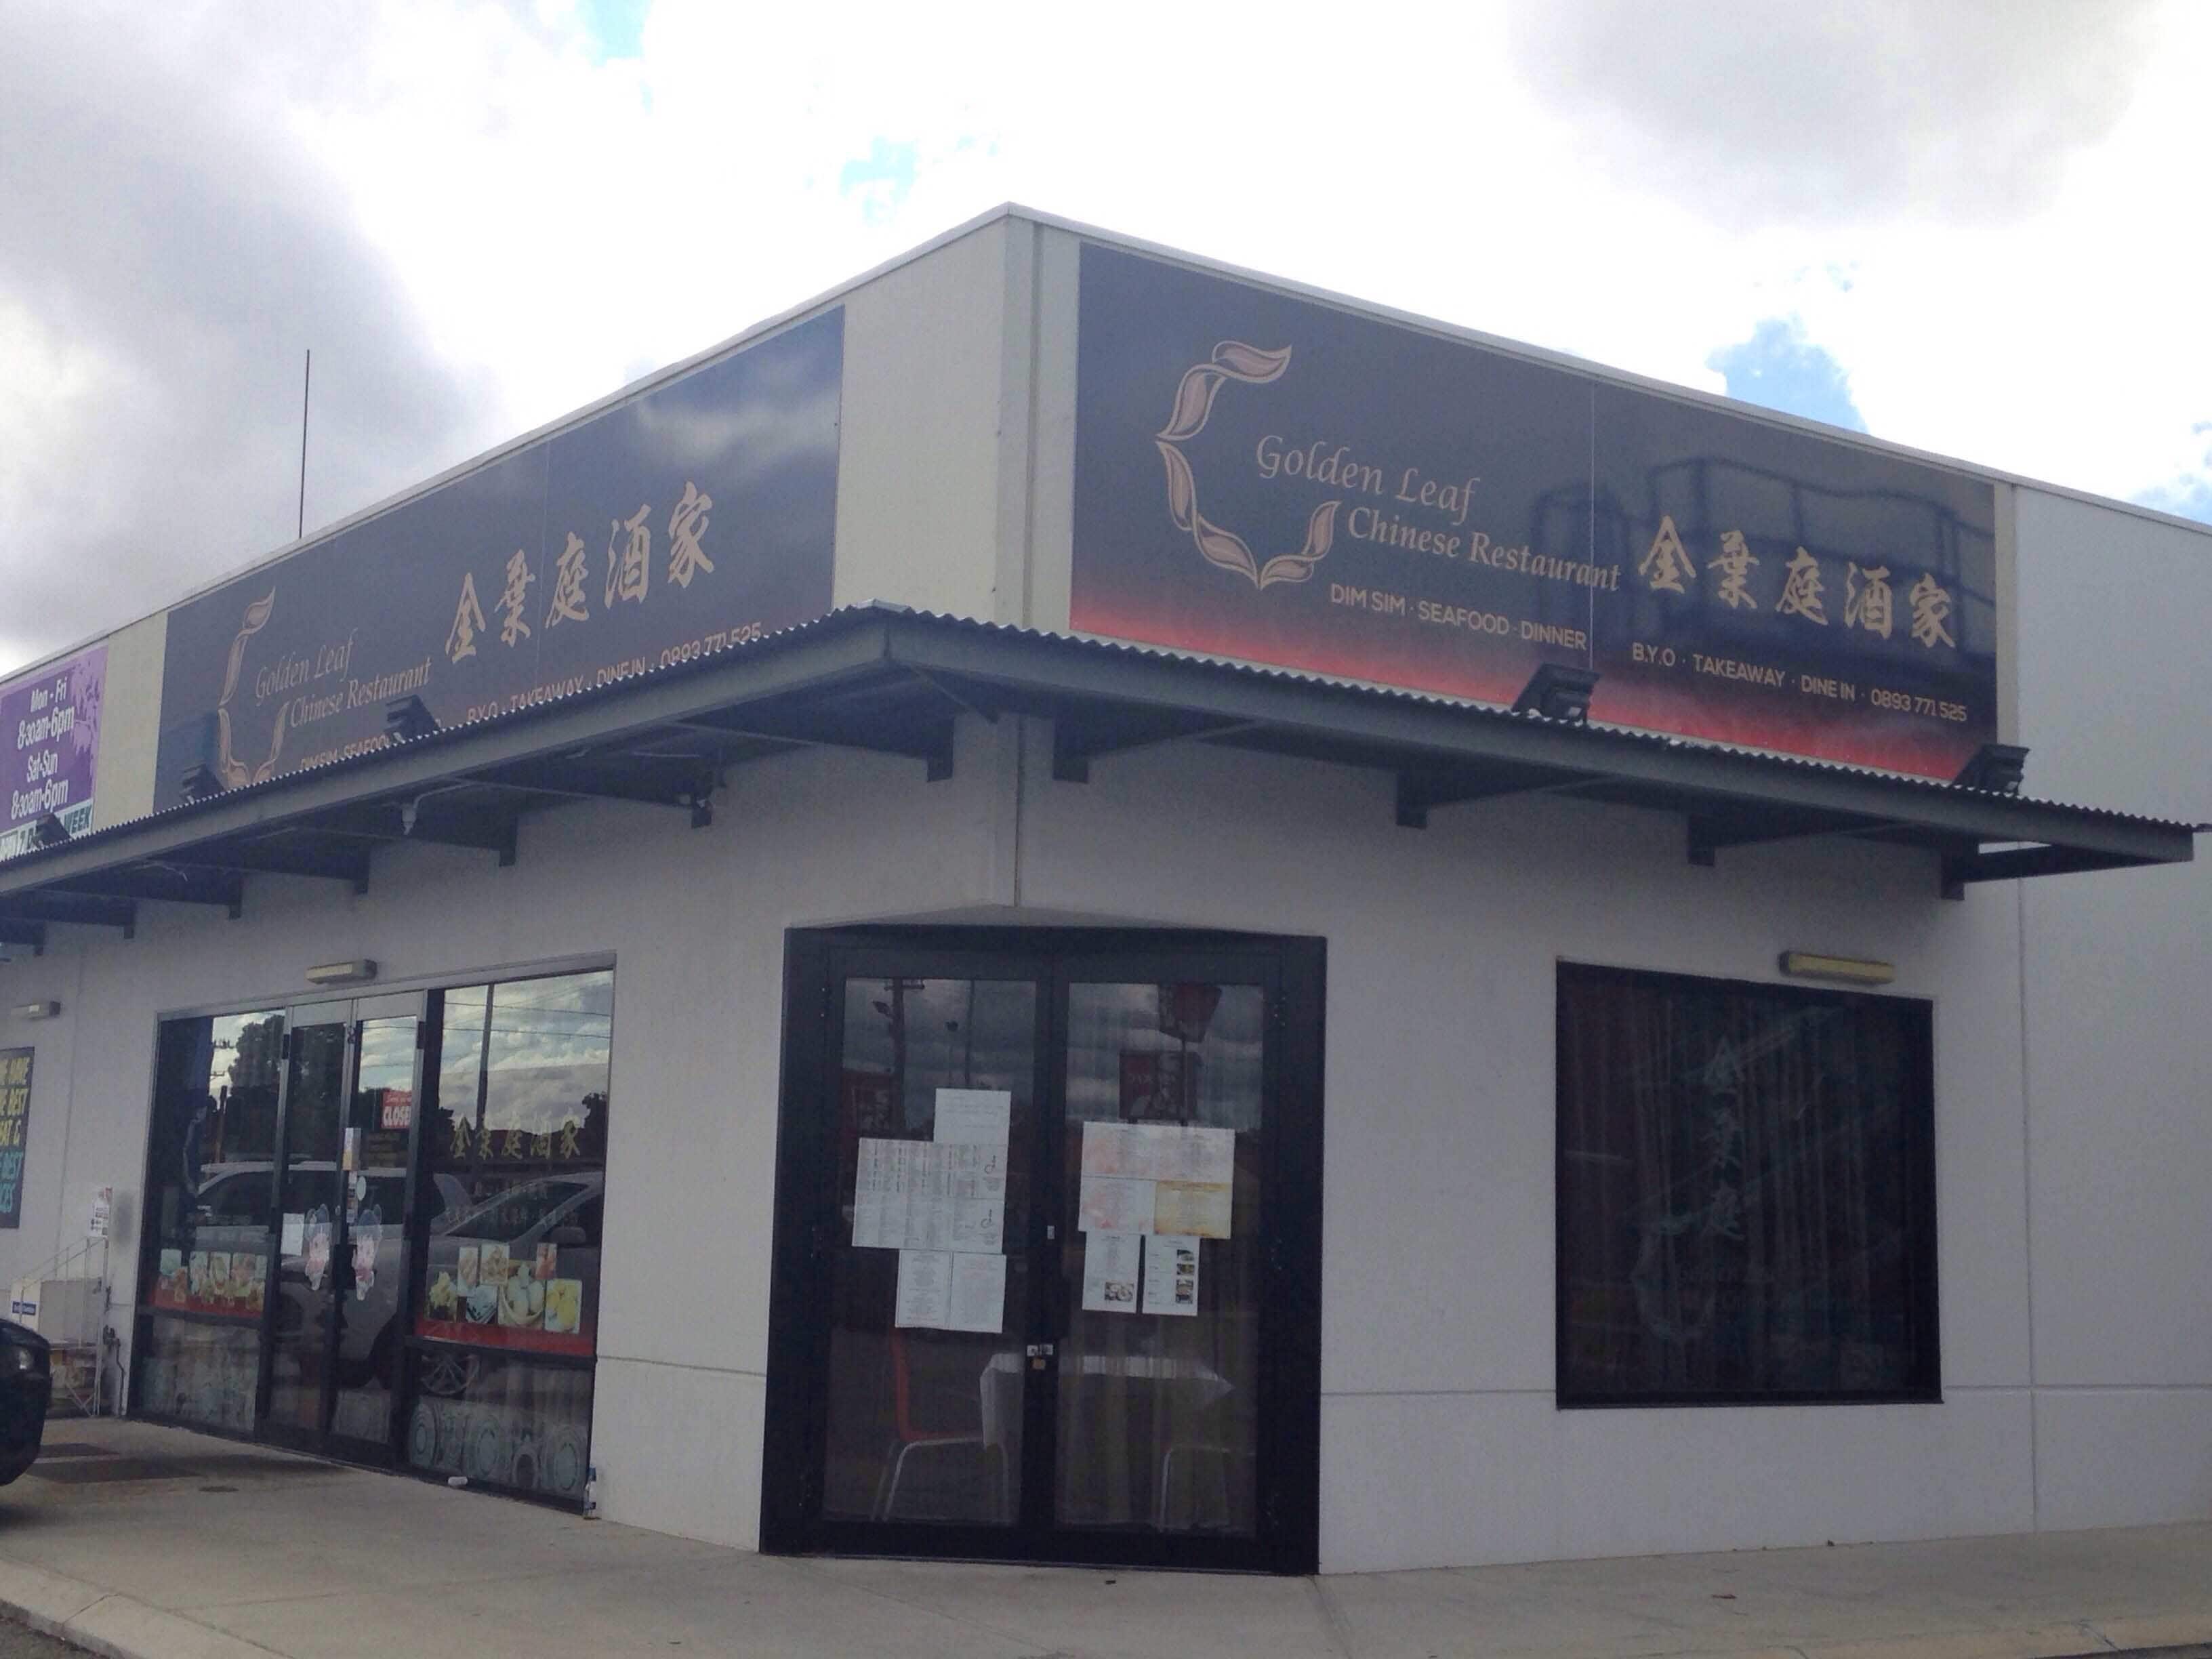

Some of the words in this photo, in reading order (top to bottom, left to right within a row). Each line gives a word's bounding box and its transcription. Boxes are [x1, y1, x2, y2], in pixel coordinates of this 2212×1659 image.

[1256, 435, 1384, 495] Golden
[1396, 468, 1481, 526] Leaf
[1347, 507, 1461, 557] Chinese
[1469, 531, 1622, 592] Restaurant
[1330, 583, 1367, 608] DIM
[1371, 592, 1406, 616] SIM
[1418, 600, 1510, 635] SEAFOOD
[1521, 620, 1587, 651] DINNER
[30, 688, 48, 712] Mon
[55, 676, 68, 703] Fri
[255, 651, 310, 707] Golden
[314, 627, 359, 683] Leaf
[290, 691, 344, 729] Chinese
[346, 655, 433, 710] Restaurant
[1692, 653, 1786, 688] TAKEAWAY
[1800, 674, 1838, 699] DINE
[1840, 682, 1856, 701] IN
[1870, 687, 1910, 712] 0893
[1914, 696, 1936, 717] 771
[1940, 702, 1968, 722] 525
[384, 1105, 411, 1127] CLOSE
